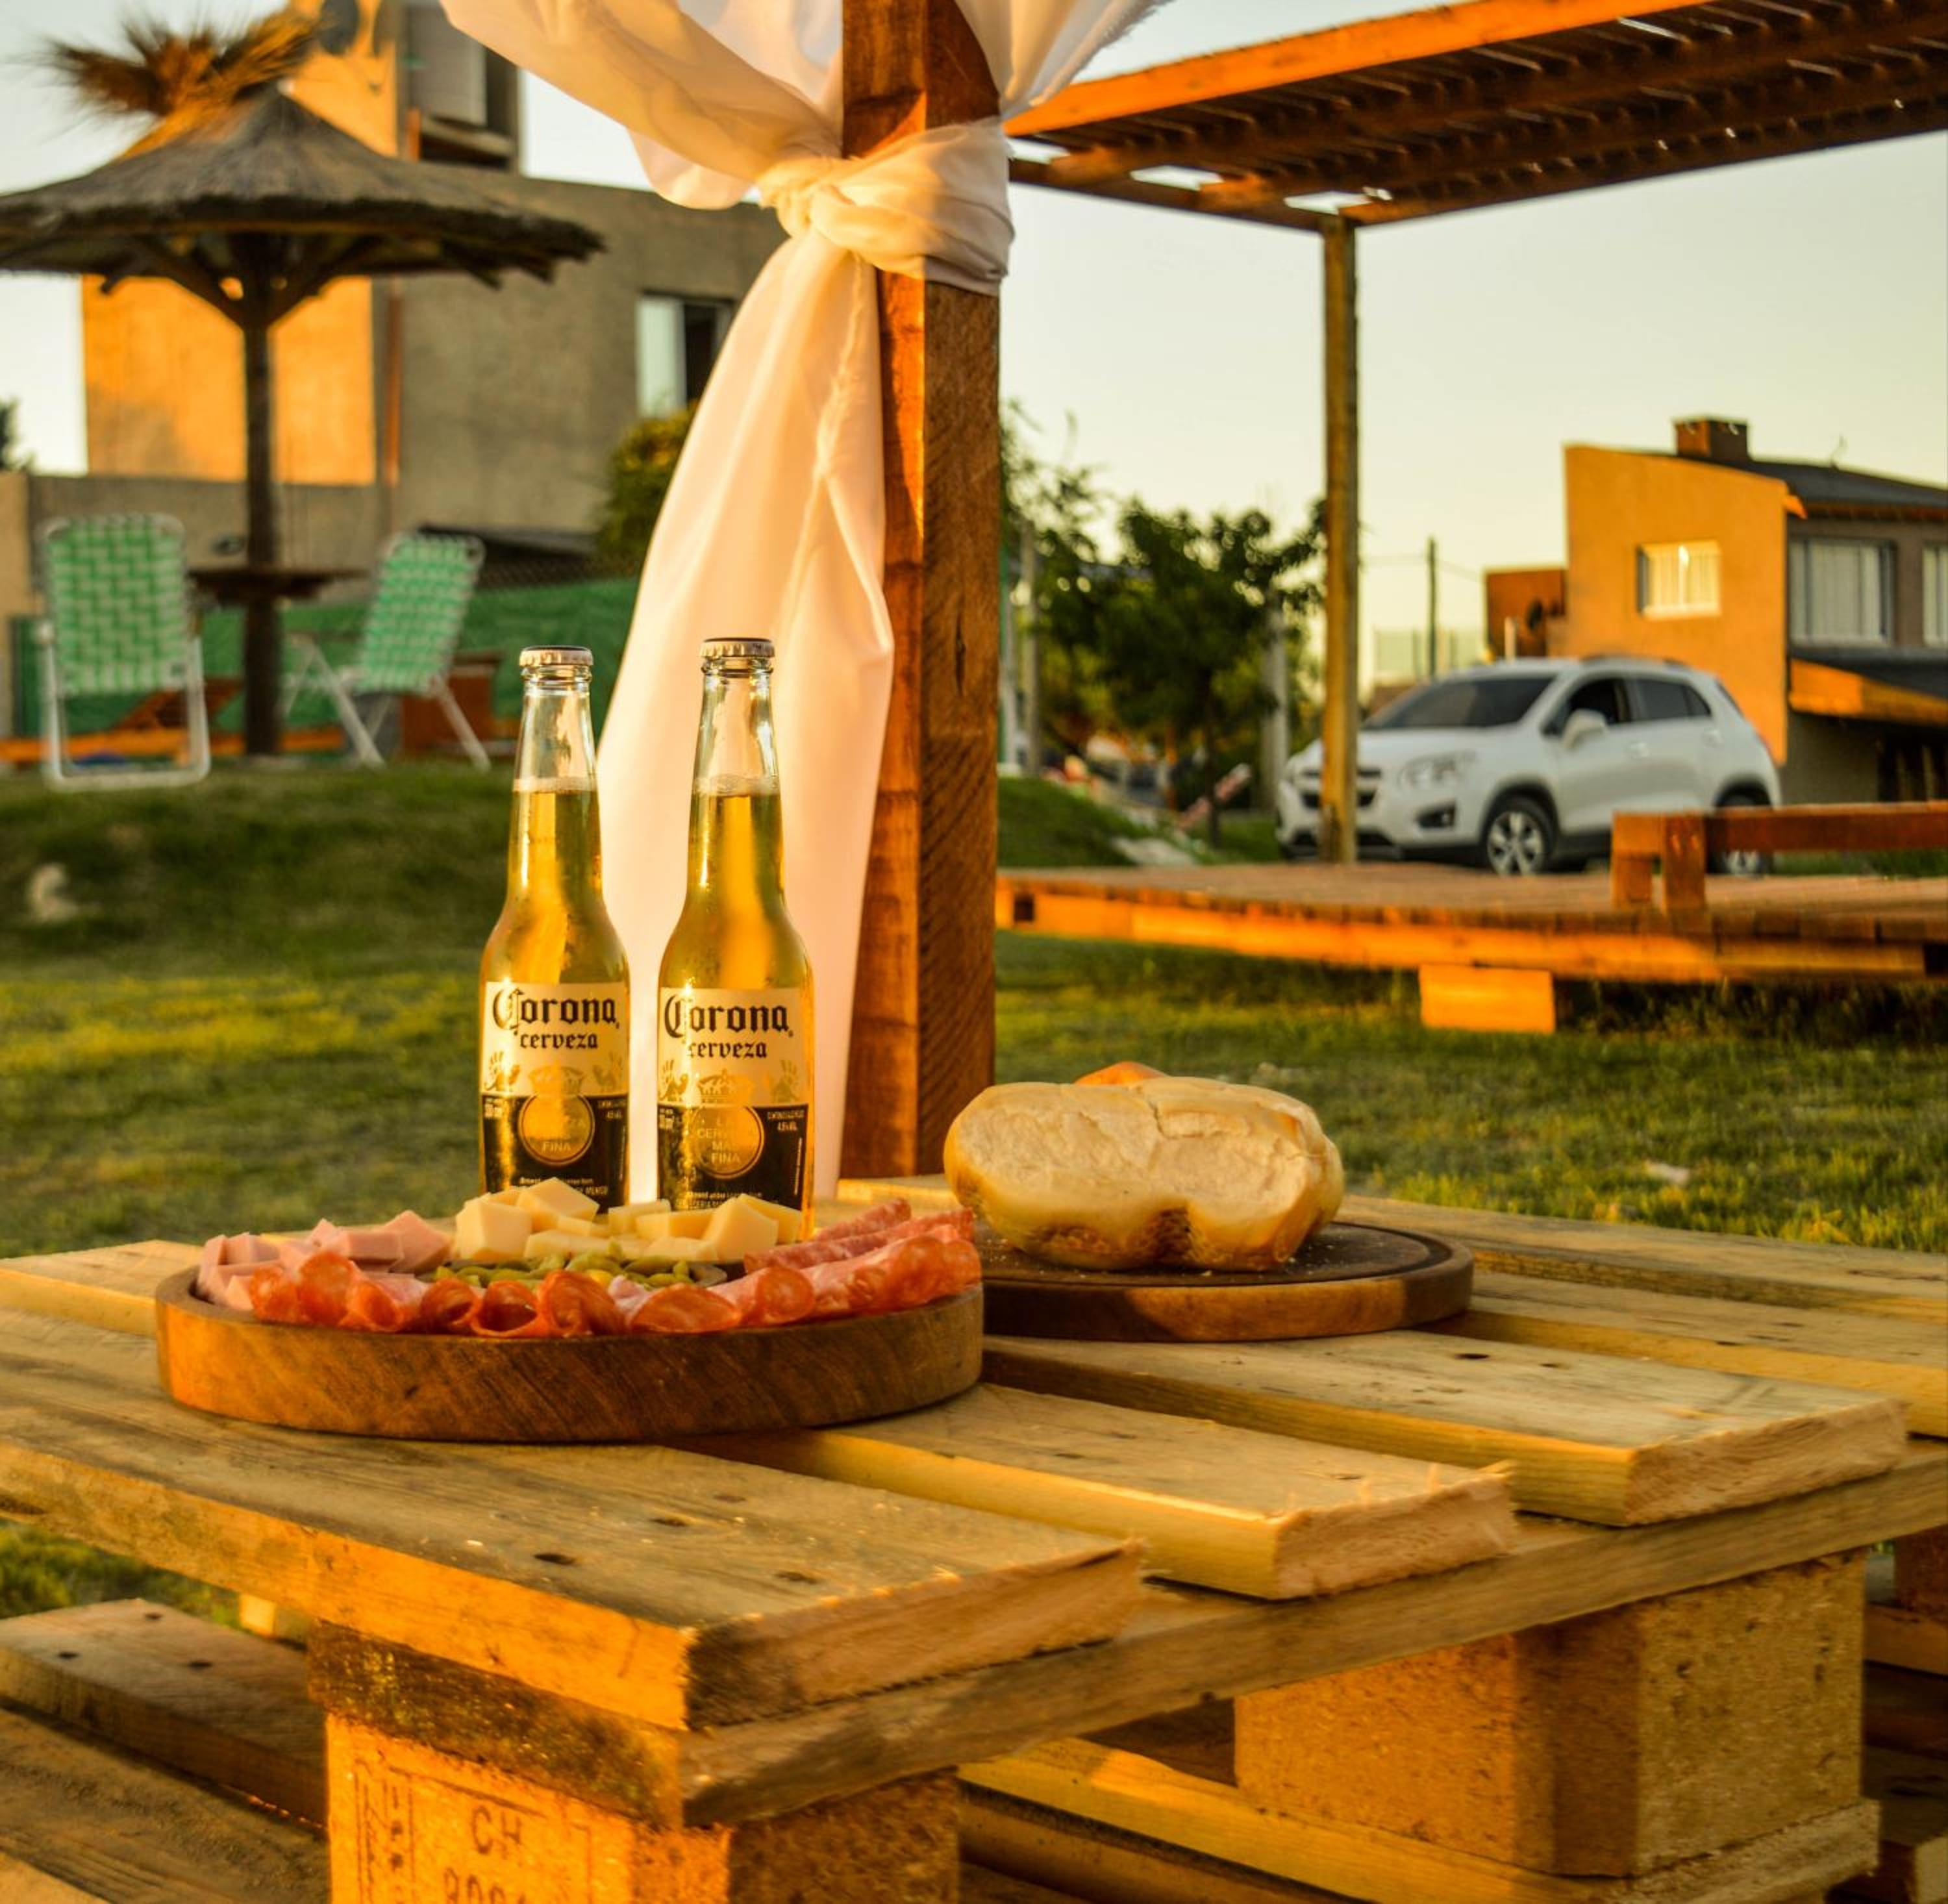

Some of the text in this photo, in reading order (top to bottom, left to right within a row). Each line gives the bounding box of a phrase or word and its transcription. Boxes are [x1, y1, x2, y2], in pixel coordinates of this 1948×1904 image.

[493, 988, 616, 1036] Corona
[664, 995, 790, 1038] Corona
[520, 1033, 599, 1049] cerveza
[688, 1042, 768, 1058] cerveza
[541, 1140, 572, 1152] FINA
[710, 1152, 741, 1164] FINA
